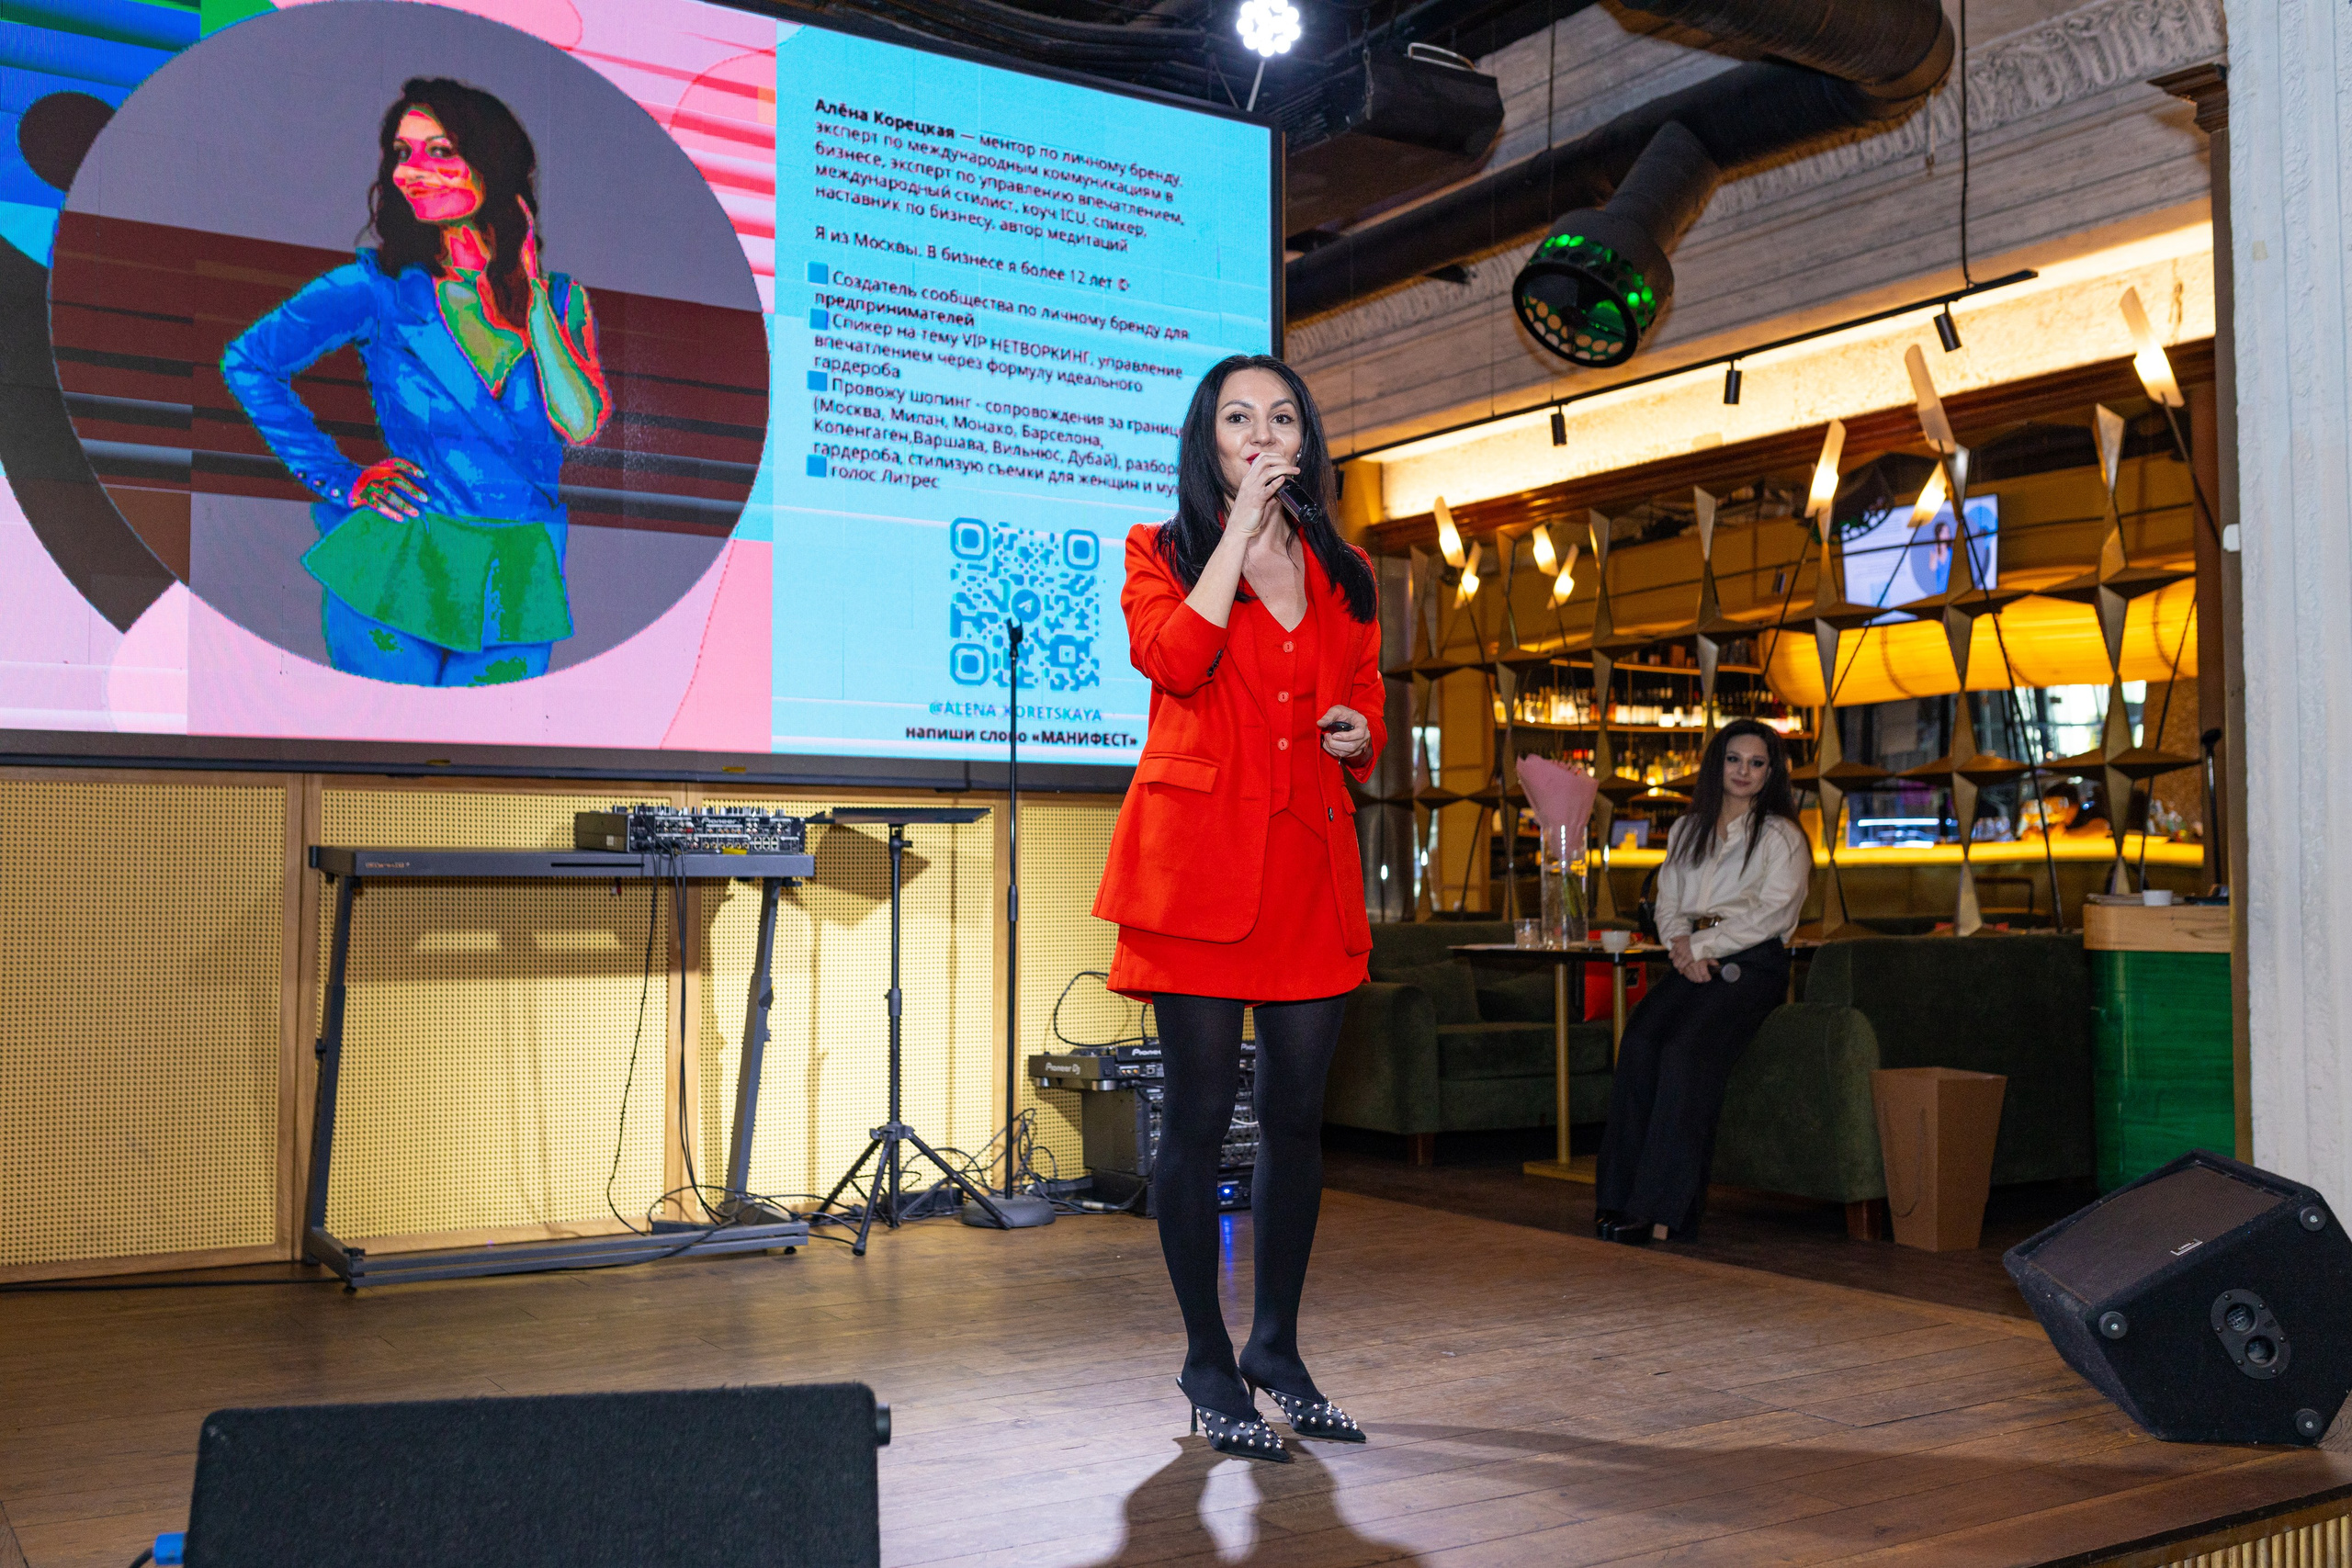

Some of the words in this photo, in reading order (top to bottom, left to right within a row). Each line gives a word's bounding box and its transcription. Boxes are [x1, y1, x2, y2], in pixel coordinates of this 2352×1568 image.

[815, 98, 868, 121] Алёна
[874, 110, 956, 139] Корецкая
[979, 135, 1035, 156] ментор
[1040, 145, 1058, 160] по
[1063, 152, 1126, 176] личному
[815, 121, 878, 145] эксперт
[883, 134, 903, 149] по
[908, 140, 1038, 175] международным
[1043, 166, 1161, 199] коммуникациям
[1165, 191, 1173, 203] в
[815, 141, 886, 169] бизнесе,
[890, 157, 952, 180] эксперт
[956, 170, 976, 184] по
[979, 175, 1074, 203] управлению
[1079, 195, 1184, 225] впечатлением,
[815, 164, 951, 199] международный
[1023, 203, 1057, 221] коуч
[815, 186, 900, 211] наставник
[905, 202, 925, 216] по
[1000, 220, 1044, 240] автор
[1047, 228, 1128, 253] медитаций
[815, 225, 825, 240] Я
[830, 231, 849, 244] из
[927, 244, 937, 258] В
[942, 247, 1004, 271] бизнесе
[1008, 261, 1017, 273] я
[1021, 261, 1065, 281] более
[1070, 269, 1085, 284] 12
[1089, 275, 1113, 289] лет
[814, 292, 975, 327] предпринимателей
[832, 270, 917, 298] Создатель
[921, 288, 1014, 313] сообщества
[1018, 304, 1036, 317] по
[1042, 307, 1106, 330] личному
[1110, 316, 1160, 339] бренду
[1164, 327, 1189, 341] для
[814, 335, 933, 363] впечатлением
[937, 354, 983, 371] через
[987, 359, 1053, 385] формулу
[1057, 373, 1143, 393] идеального
[814, 355, 900, 378] гардероба
[832, 313, 893, 338] Спикер
[897, 326, 916, 339] на
[922, 329, 958, 348] тему
[962, 333, 987, 348] VIP
[1098, 356, 1183, 379] управление
[813, 395, 885, 422] (Москва,
[890, 407, 948, 429] Милан,
[954, 415, 1017, 437] Монако,
[1022, 425, 1103, 448] Барселона,
[831, 378, 905, 403] Провожу
[910, 390, 971, 409] шопинг
[985, 401, 1103, 426] сопровождения
[1109, 417, 1124, 429] за
[813, 442, 903, 465] гардероба,
[908, 454, 983, 476] стилизую
[988, 463, 1044, 479] съемки
[1048, 470, 1074, 484] для
[1079, 474, 1138, 491] женщин
[1143, 480, 1152, 491] и
[831, 465, 876, 482] голос
[881, 468, 940, 490] Литрес
[993, 441, 1064, 462] Вильнюс,
[906, 727, 976, 741] напиши
[1032, 730, 1138, 748] «МАНИФЕСТ»
[1045, 1062, 1071, 1073] Pioneer
